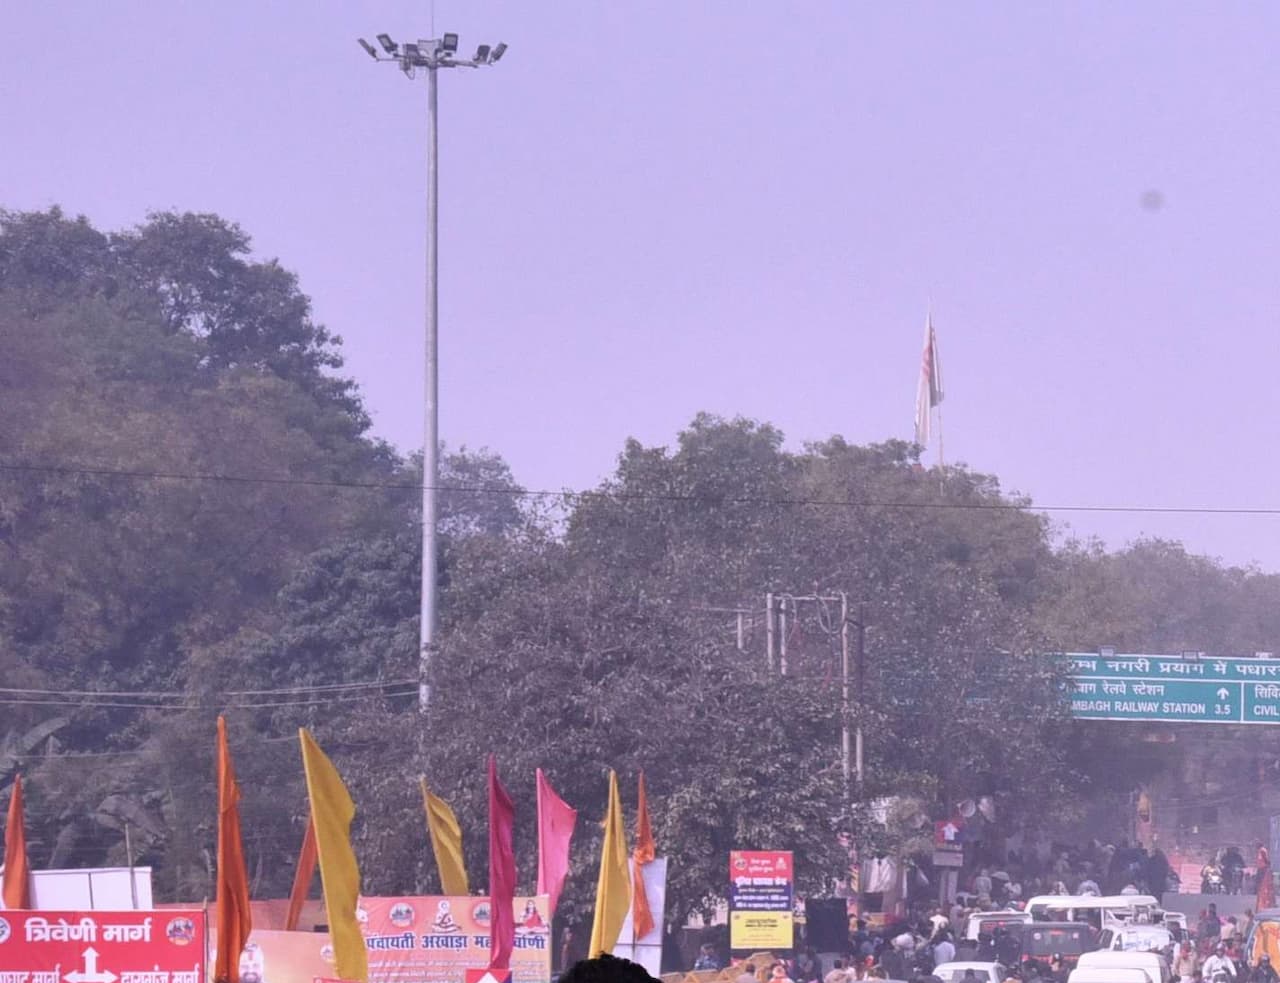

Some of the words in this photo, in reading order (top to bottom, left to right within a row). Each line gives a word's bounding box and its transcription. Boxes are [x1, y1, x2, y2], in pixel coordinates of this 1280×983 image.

[1105, 658, 1150, 673] नगरी
[1159, 661, 1205, 675] प्रयाग
[1213, 659, 1228, 676] में
[1102, 680, 1127, 696] रेलवे
[1132, 681, 1165, 696] स्टेशन
[1114, 701, 1159, 713] RAILWAY
[1162, 702, 1206, 714] STATION
[1213, 703, 1232, 715] 3.5
[1253, 705, 1280, 717] CIVIL
[24, 916, 97, 943] त्रिवेणी
[102, 916, 153, 943] मार्ग
[366, 931, 415, 949] पंचायती
